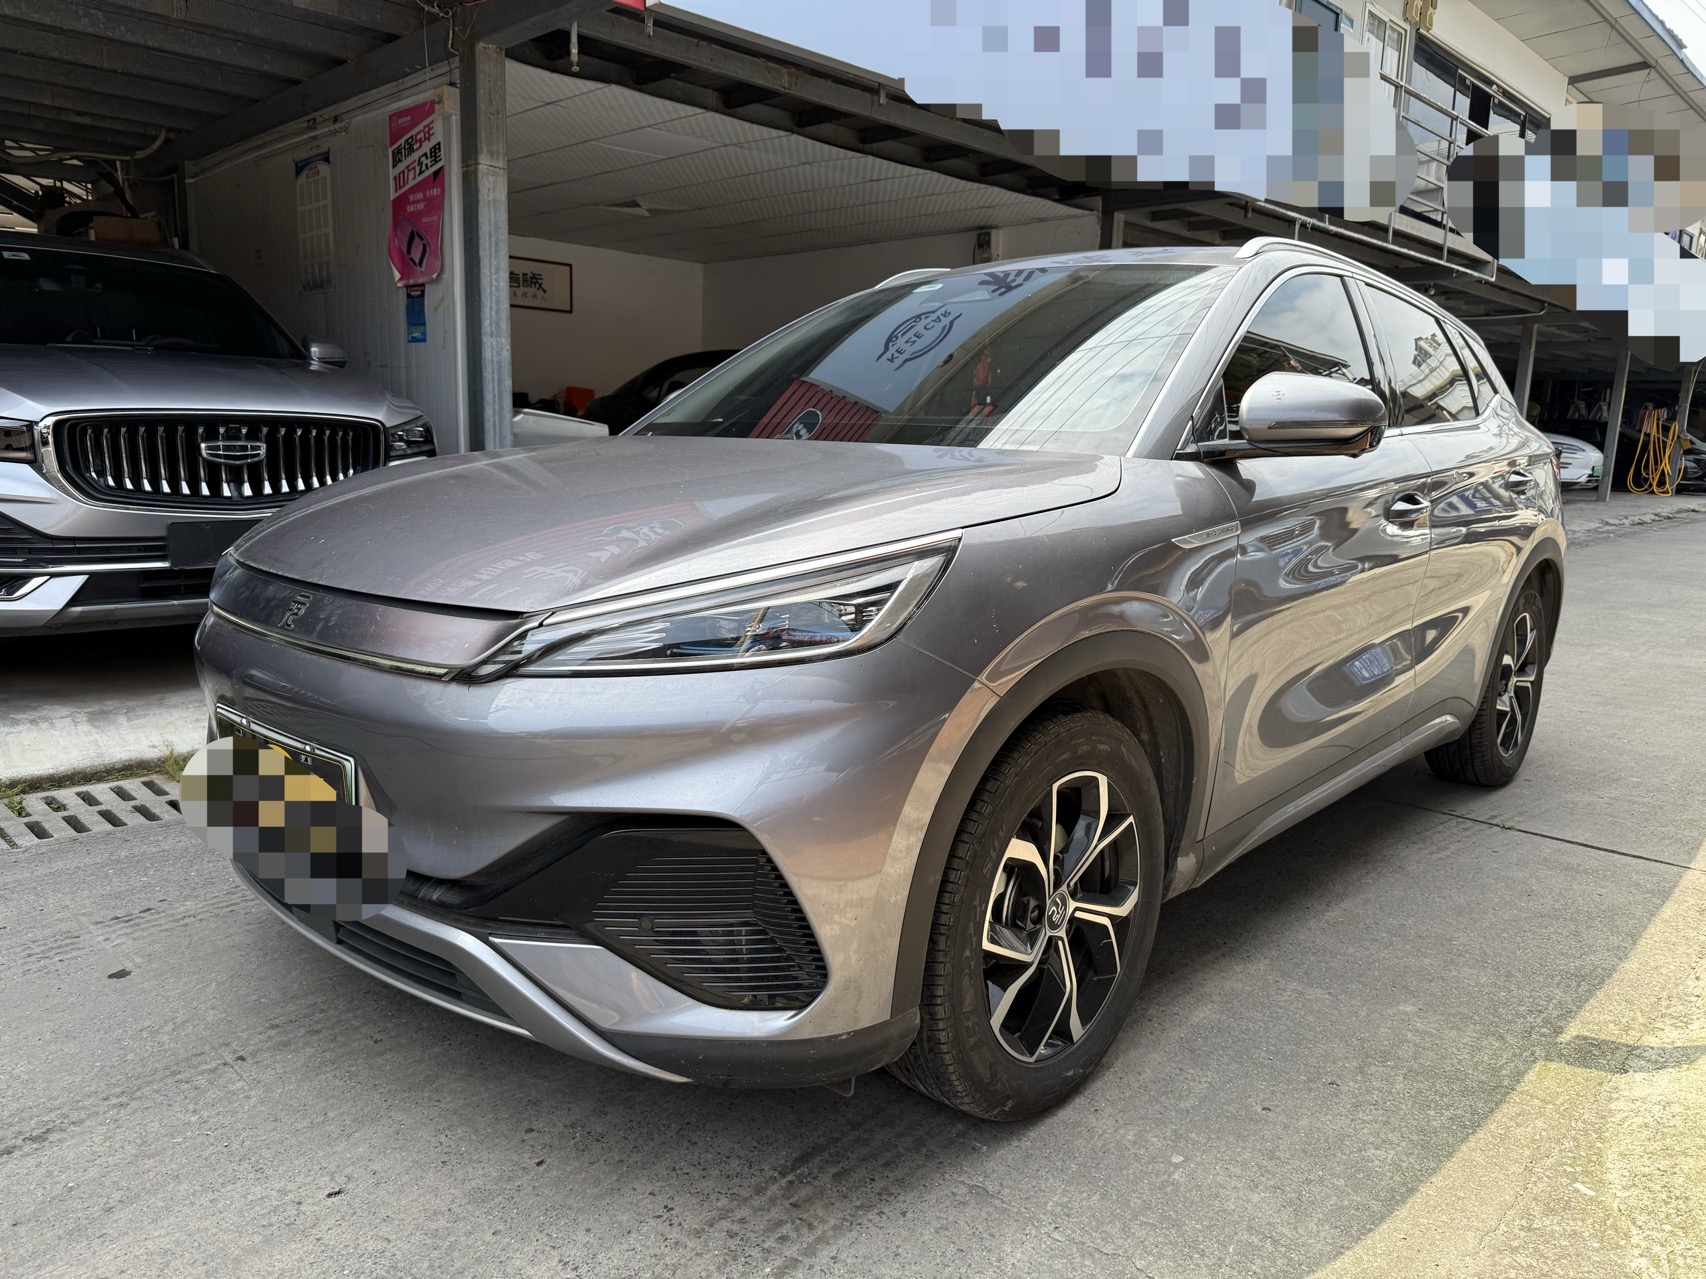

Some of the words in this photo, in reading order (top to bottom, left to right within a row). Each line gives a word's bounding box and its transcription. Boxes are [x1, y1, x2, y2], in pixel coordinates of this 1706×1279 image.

[391, 120, 435, 170] 质保5年
[393, 141, 443, 194] 10万公里
